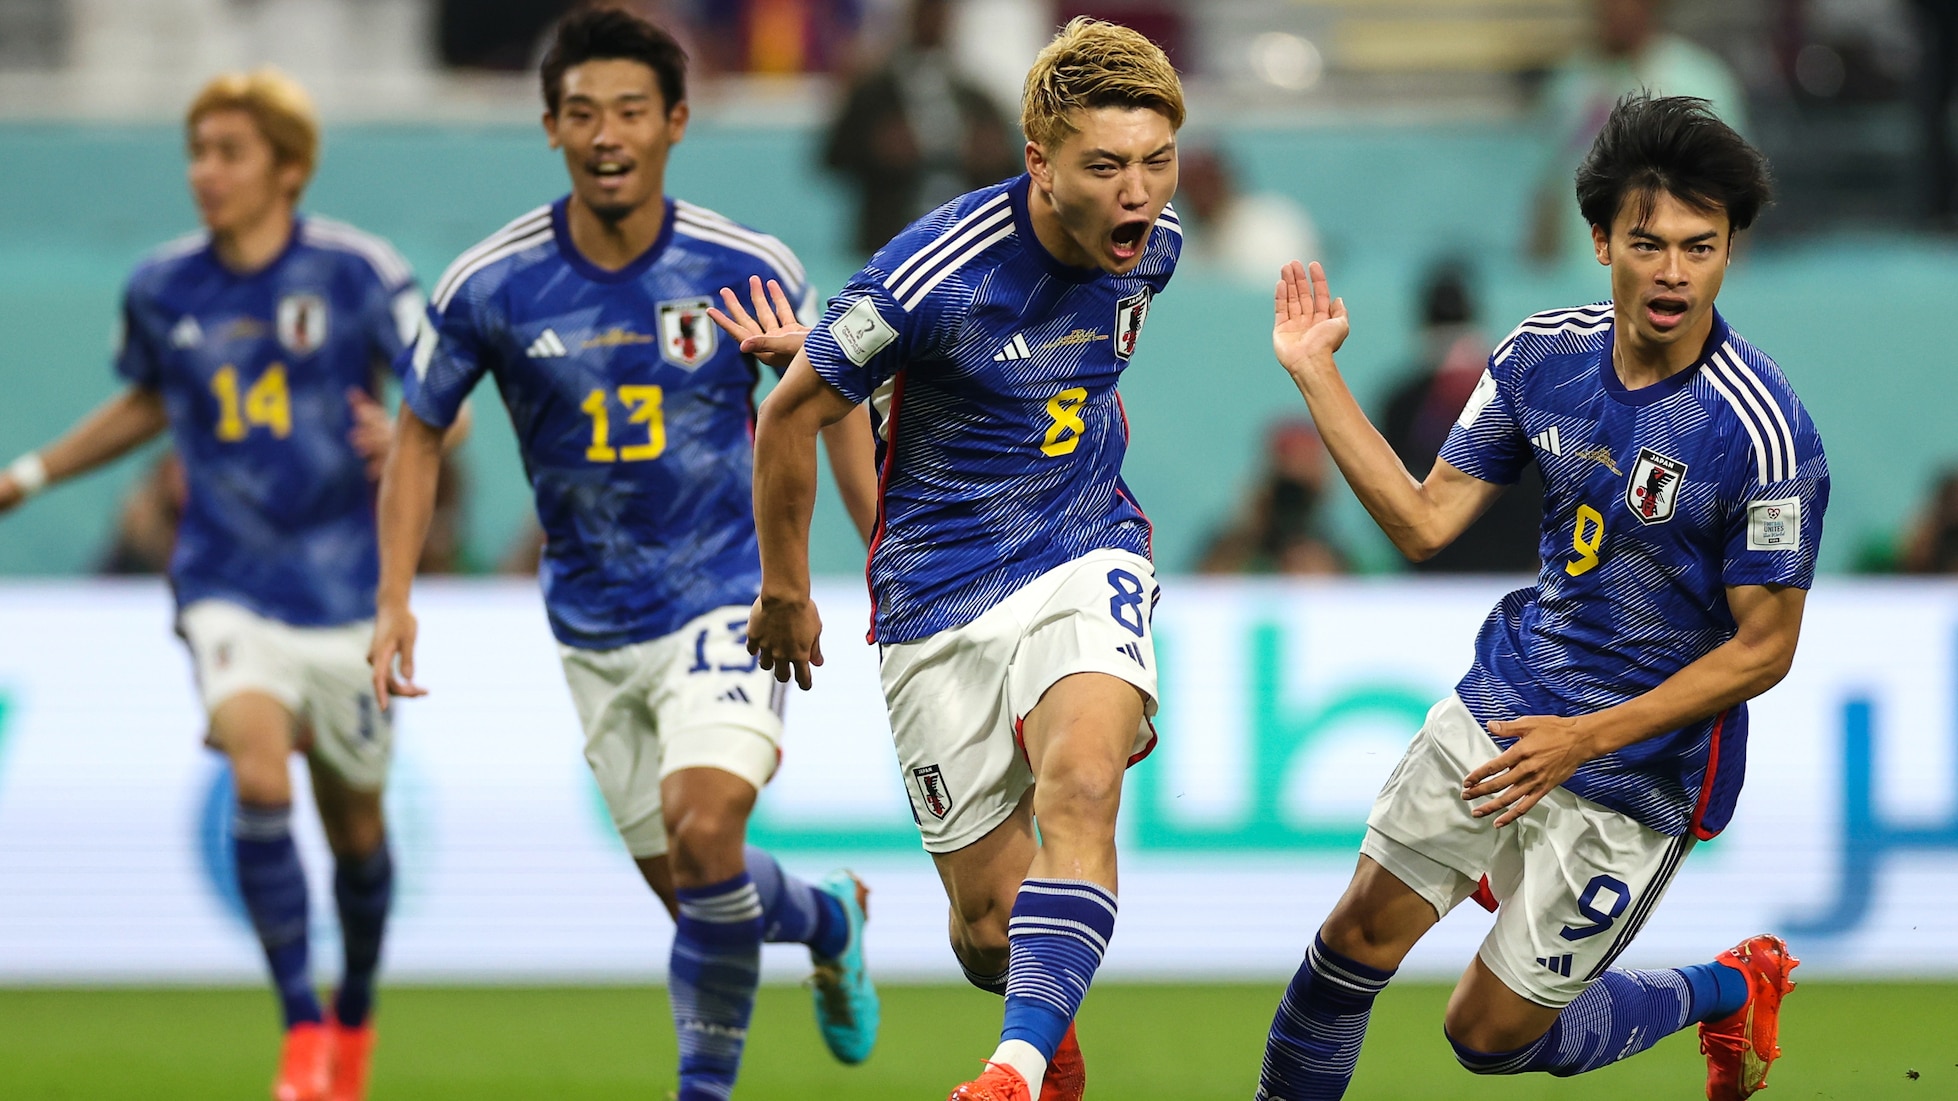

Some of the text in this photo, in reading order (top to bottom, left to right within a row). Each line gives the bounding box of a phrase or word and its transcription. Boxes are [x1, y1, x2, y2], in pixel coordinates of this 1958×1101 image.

[210, 362, 291, 442] 14
[581, 384, 666, 463] 13
[1040, 387, 1088, 457] 8
[1649, 454, 1675, 469] JAPAN
[1565, 504, 1605, 577] 9
[1107, 568, 1144, 637] 8
[1559, 874, 1631, 941] 9
